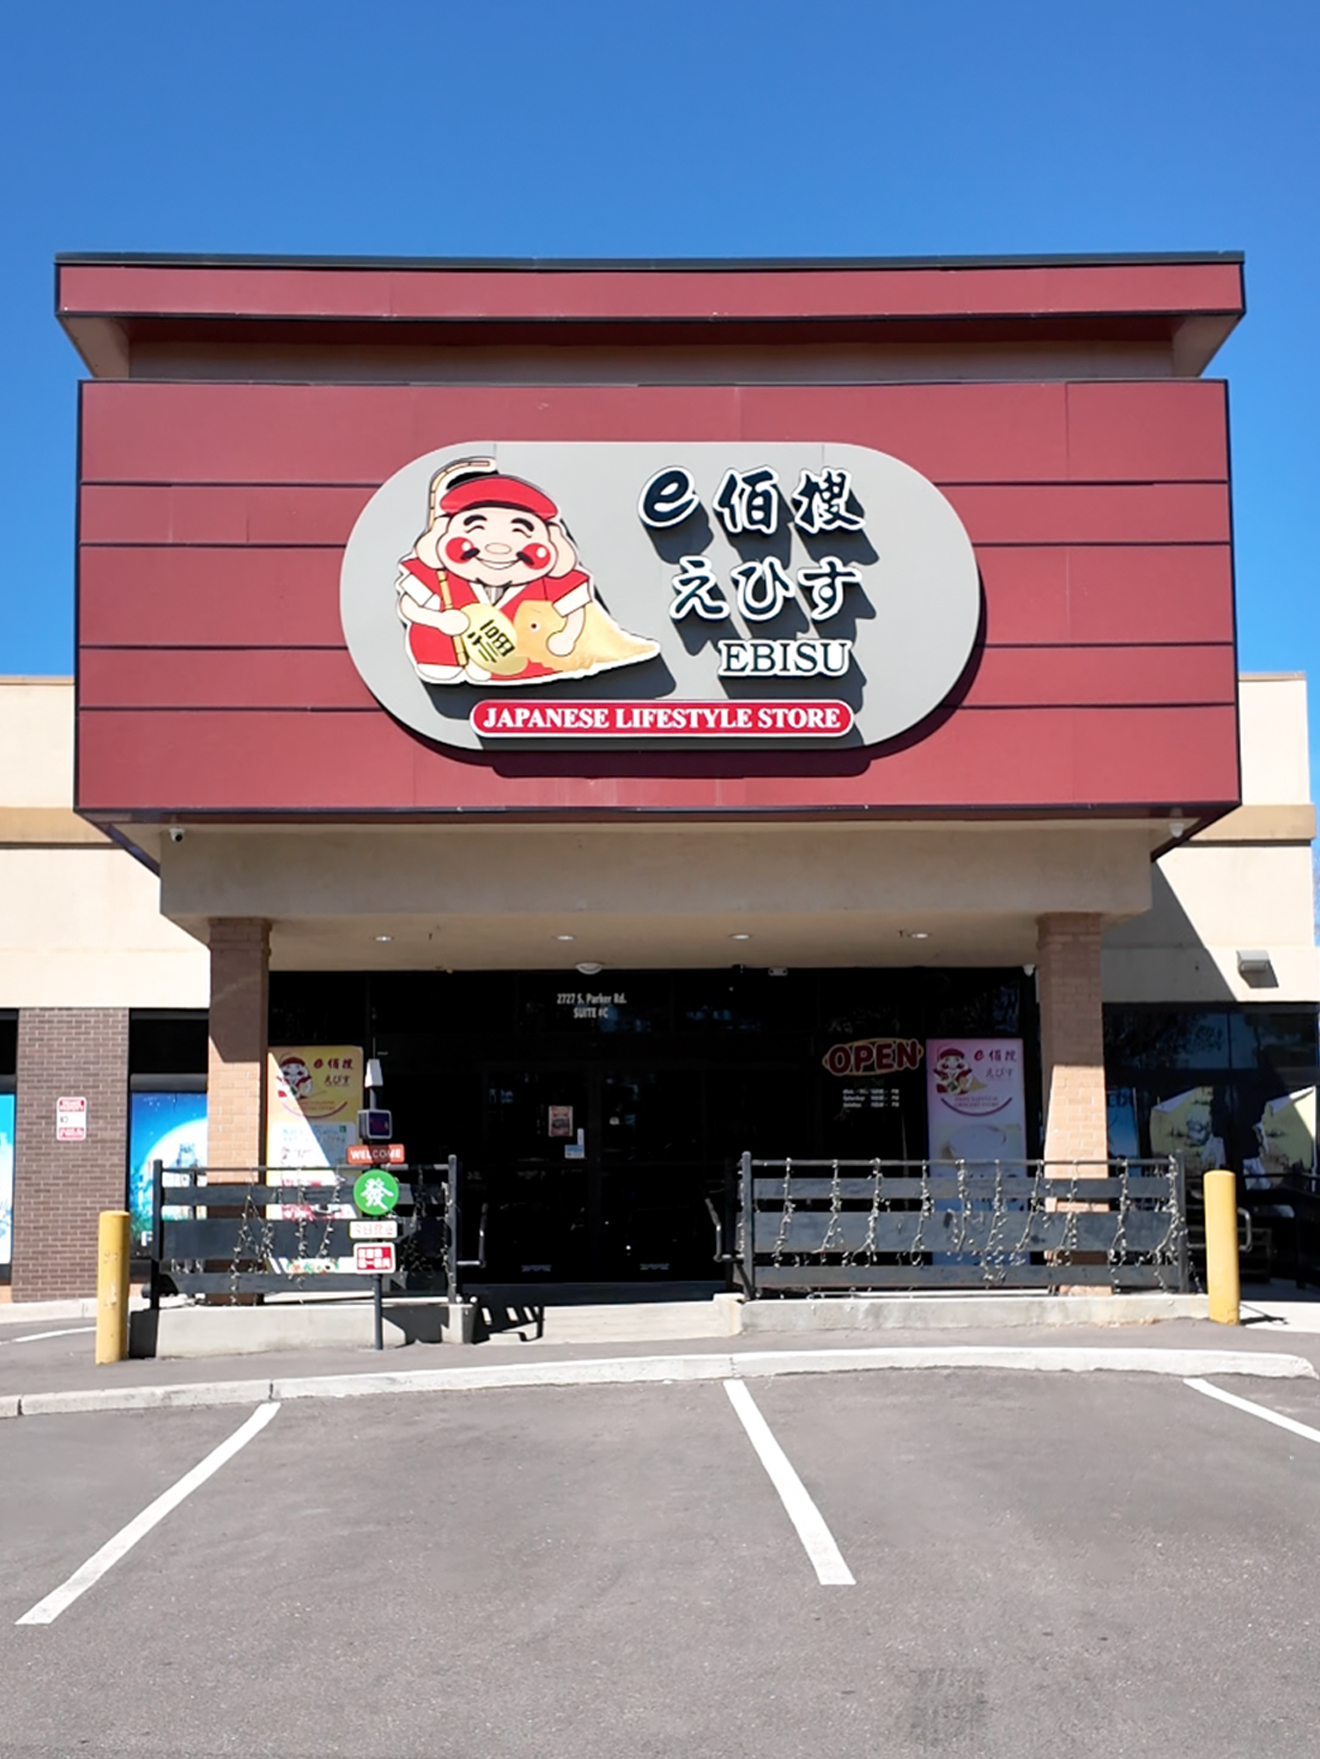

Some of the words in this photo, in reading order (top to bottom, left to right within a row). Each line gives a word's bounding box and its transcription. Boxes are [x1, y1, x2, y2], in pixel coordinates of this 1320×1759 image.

[719, 639, 853, 677] EBISU
[482, 707, 607, 729] JAPANESE
[615, 707, 752, 729] LIFESTYLE
[757, 707, 841, 729] STORE
[556, 992, 576, 1005] 2727
[586, 992, 612, 1005] Parker
[613, 992, 627, 1004] Rd.
[573, 1006, 597, 1019] SUITE
[828, 1038, 922, 1077] OPEN
[350, 1148, 402, 1160] WELCOME
